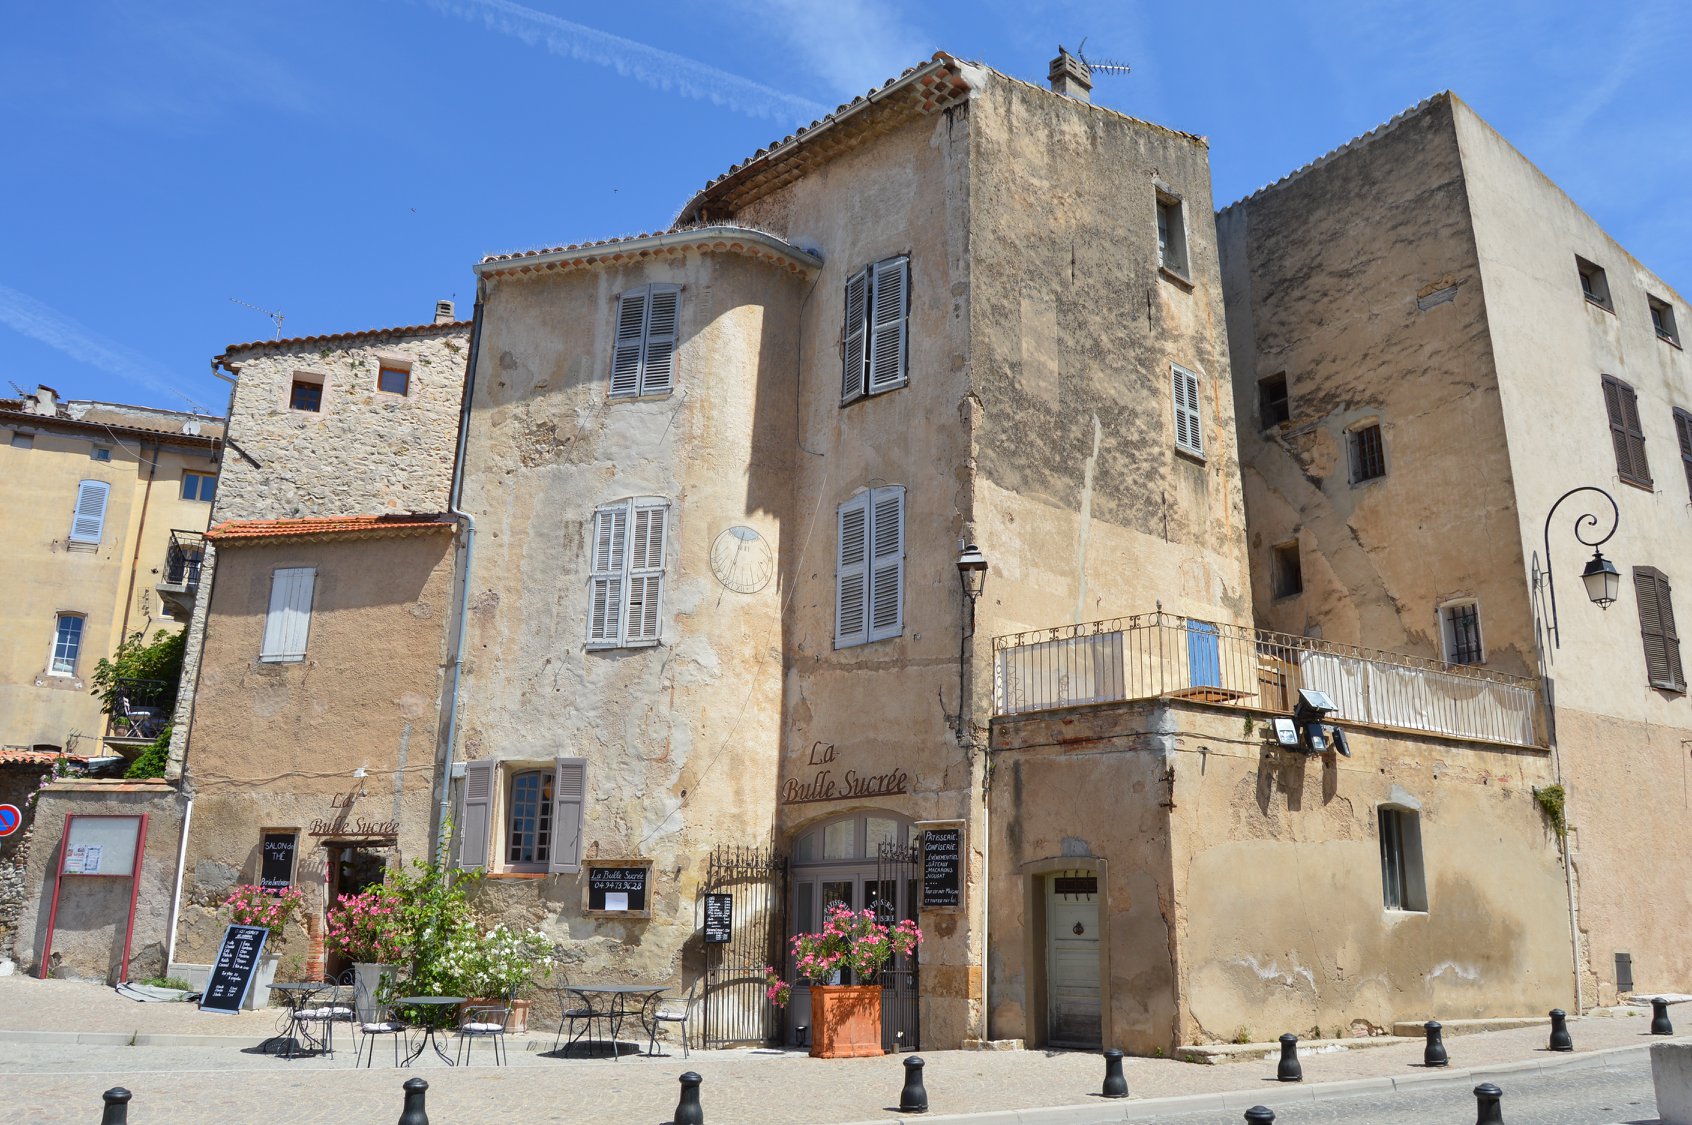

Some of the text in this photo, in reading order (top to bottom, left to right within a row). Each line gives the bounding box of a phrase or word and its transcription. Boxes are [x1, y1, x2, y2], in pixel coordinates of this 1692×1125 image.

[808, 741, 836, 765] La
[783, 768, 907, 801] Bulle Sucrée
[330, 793, 354, 808] La
[309, 816, 399, 834] Bulle Sucrée
[265, 842, 287, 850] SALON
[272, 850, 286, 860] THÉ
[592, 870, 644, 880] La Bulle Sucrée
